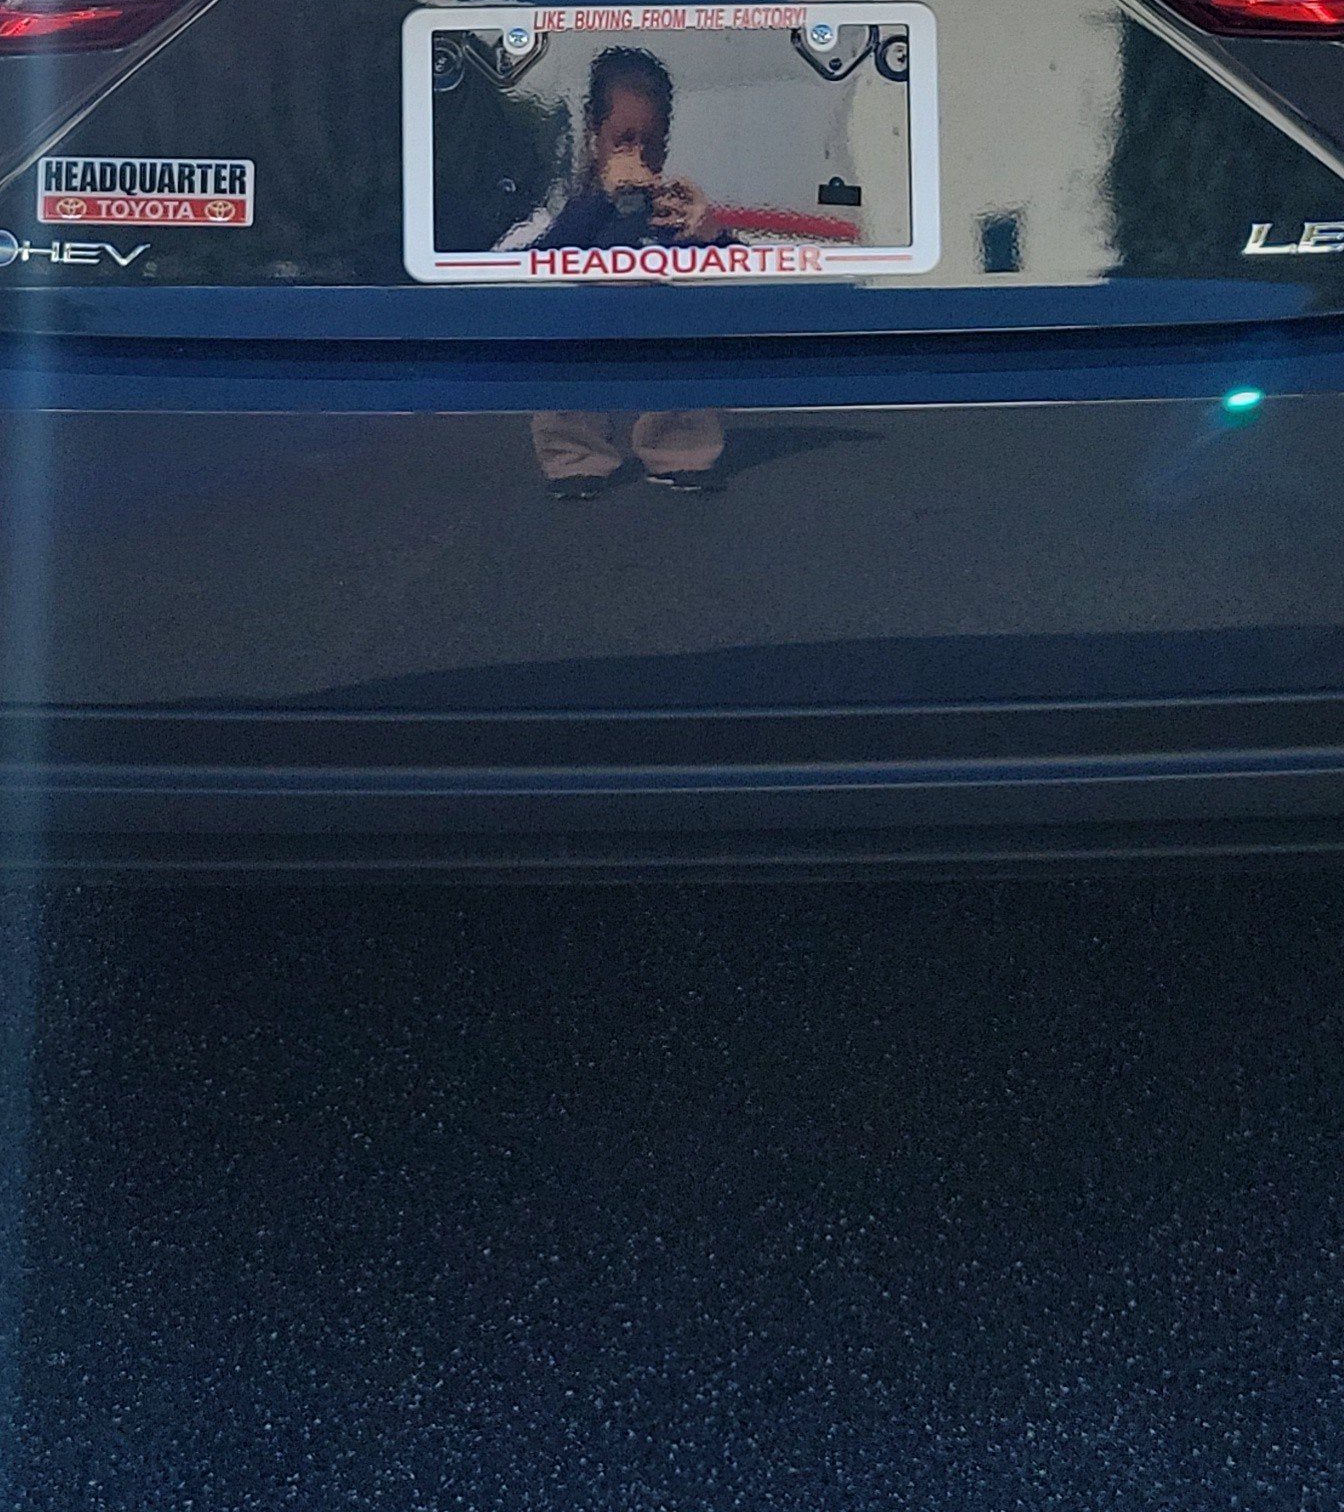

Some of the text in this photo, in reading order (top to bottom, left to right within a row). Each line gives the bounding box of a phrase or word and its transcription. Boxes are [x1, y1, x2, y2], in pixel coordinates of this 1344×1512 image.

[533, 6, 808, 31] LIKE BUYING FROM THE FACTORY!
[43, 159, 247, 196] HEADQUARTER
[96, 199, 197, 221] TOYOTA
[530, 246, 824, 276] HEADQUARTER
